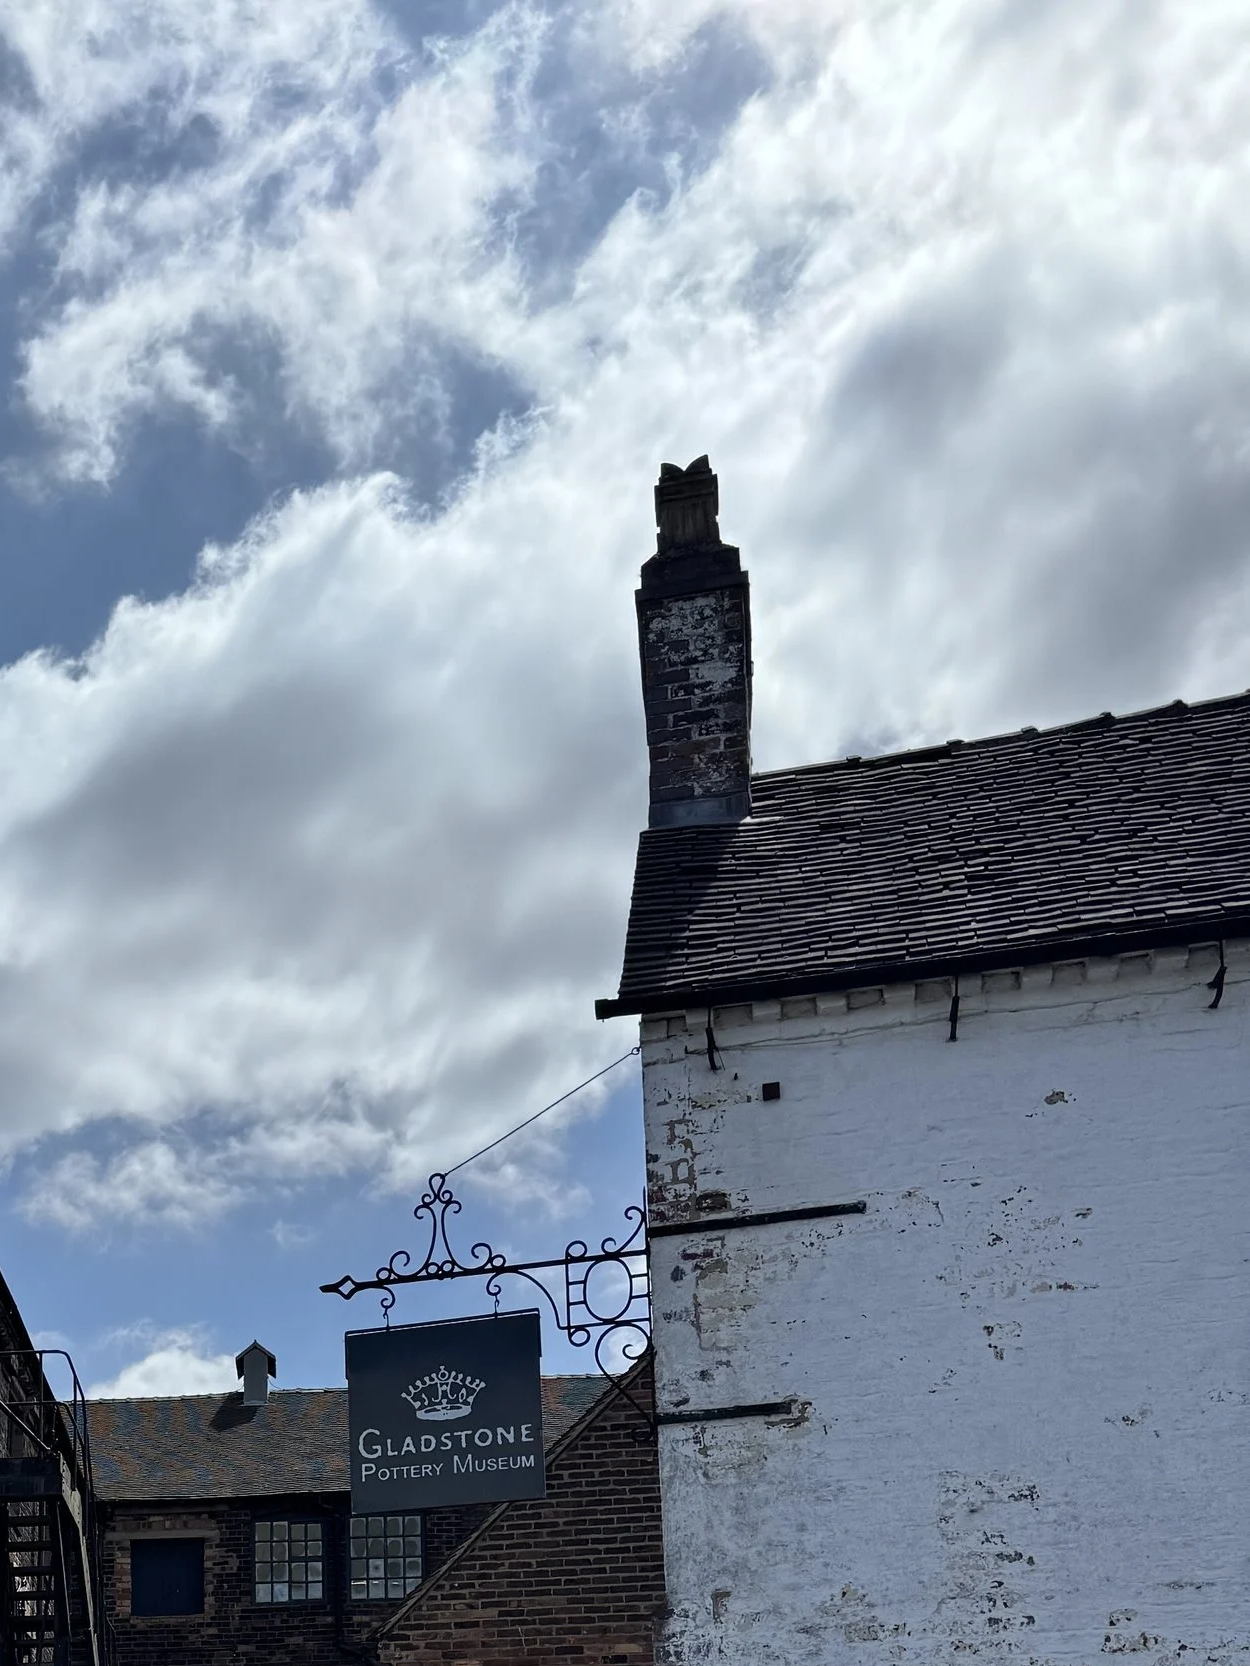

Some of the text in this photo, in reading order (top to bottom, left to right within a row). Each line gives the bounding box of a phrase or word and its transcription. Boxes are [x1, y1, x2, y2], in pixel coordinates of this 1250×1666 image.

[358, 1424, 534, 1459] GLADSTONE
[361, 1454, 535, 1482] POTTERY MUSEUM
